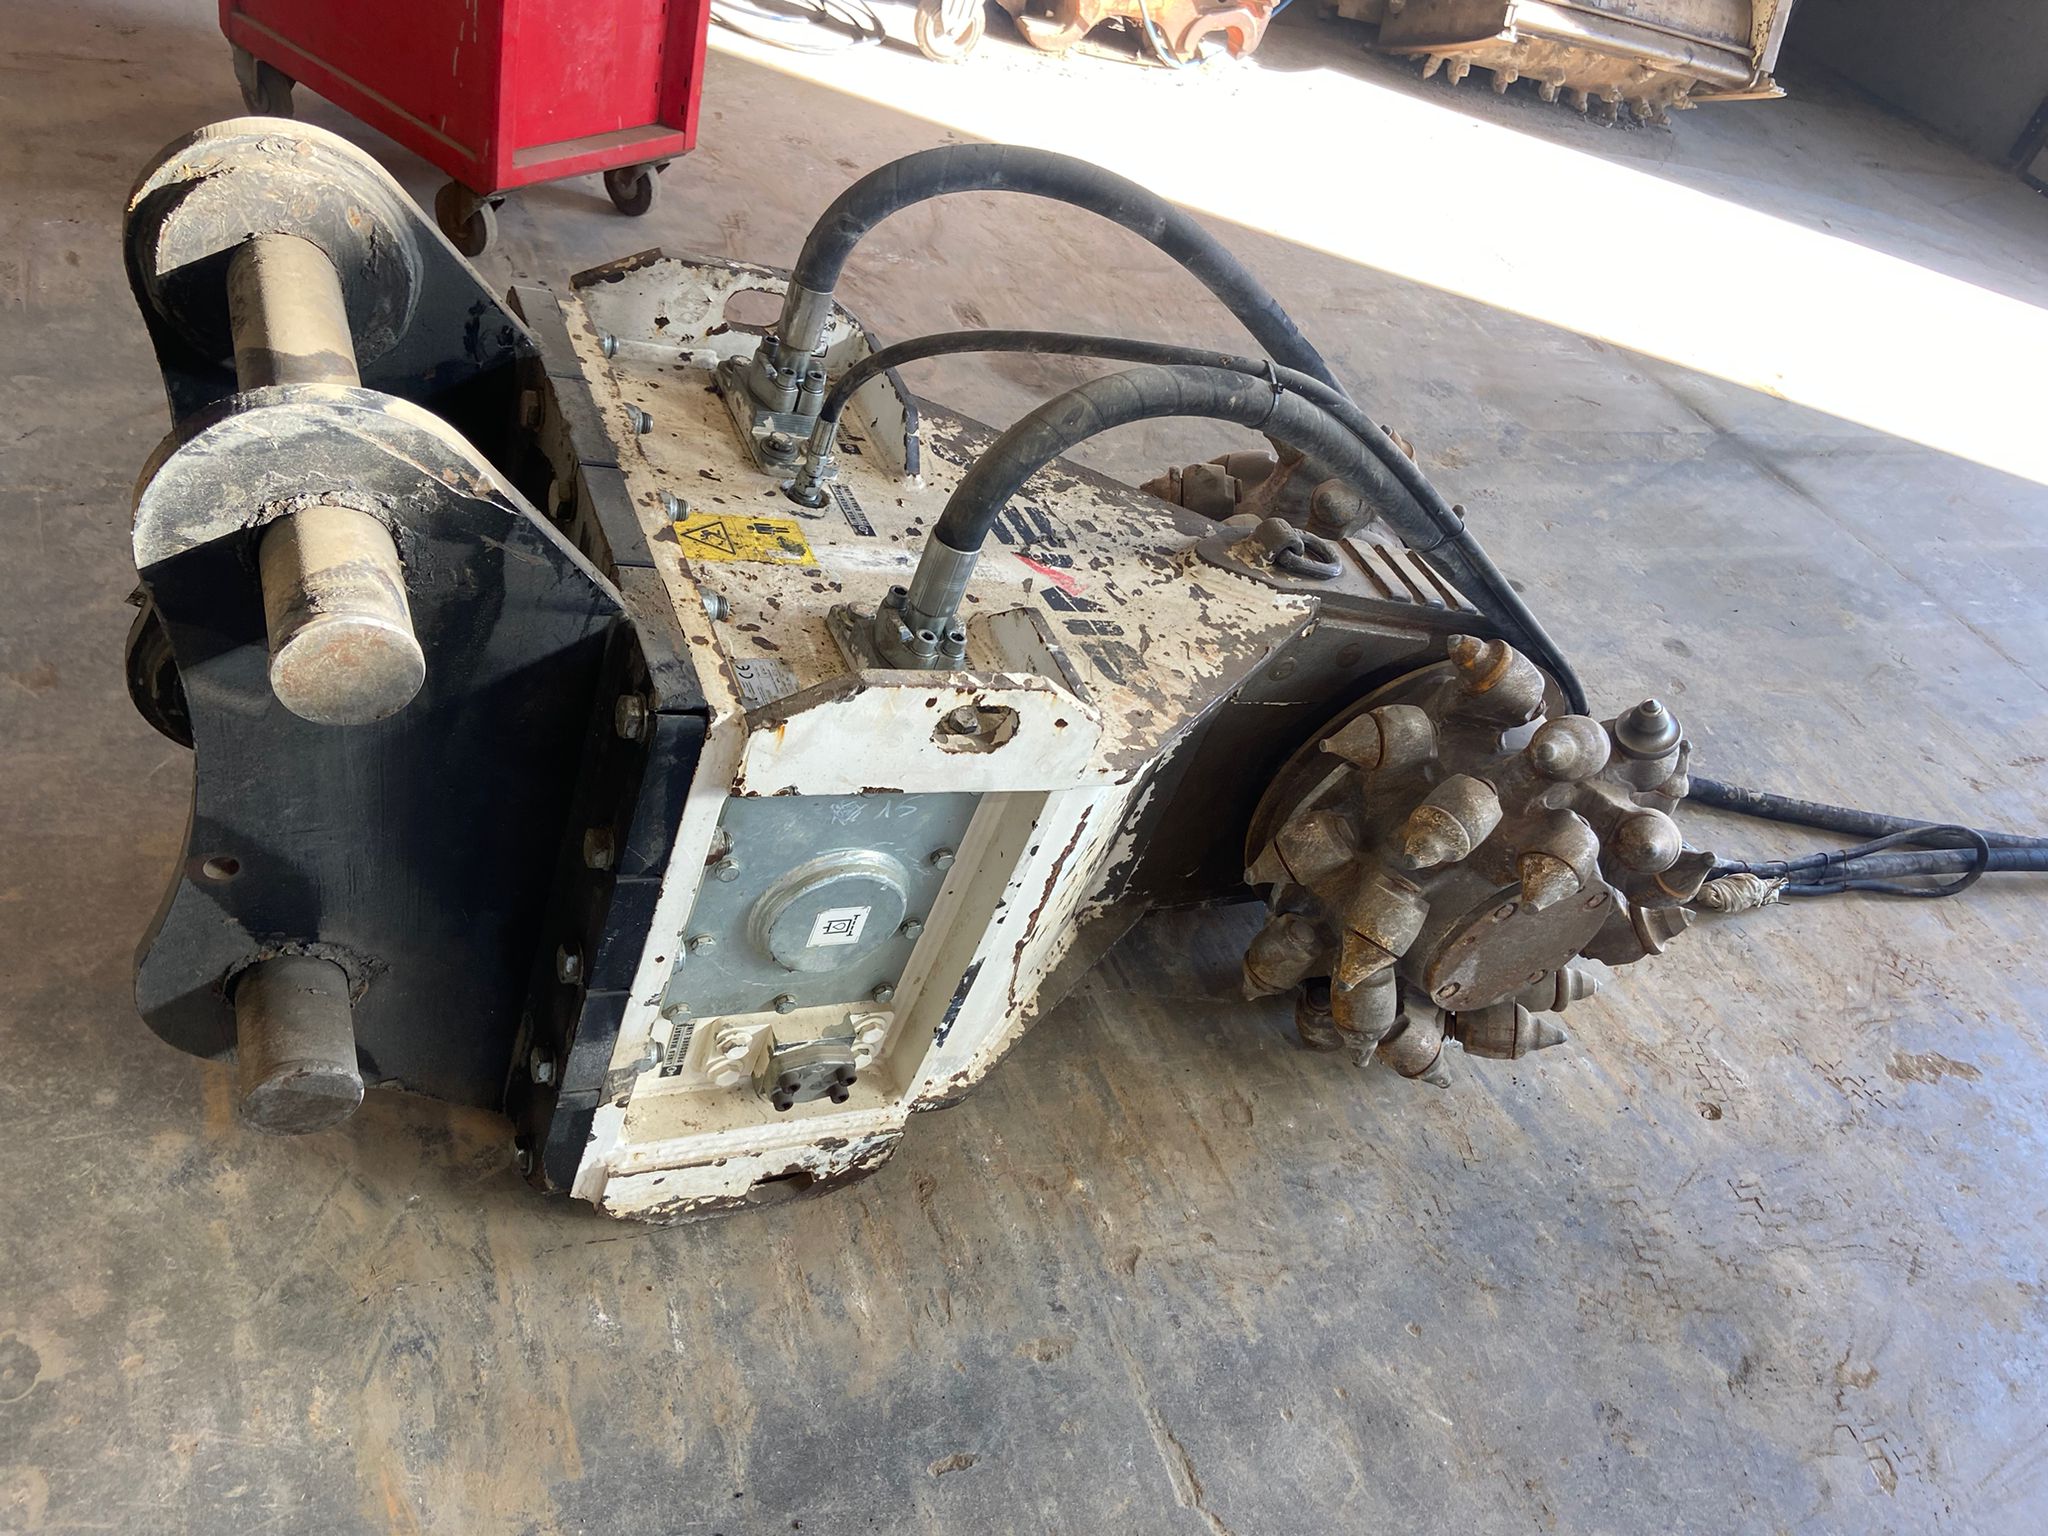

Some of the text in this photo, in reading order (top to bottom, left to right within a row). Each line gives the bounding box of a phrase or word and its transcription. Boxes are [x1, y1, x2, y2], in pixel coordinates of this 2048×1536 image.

[735, 664, 754, 679] CE
[677, 1023, 695, 1063] PRESSURE LINE
[665, 1050, 676, 1066] LINEA
